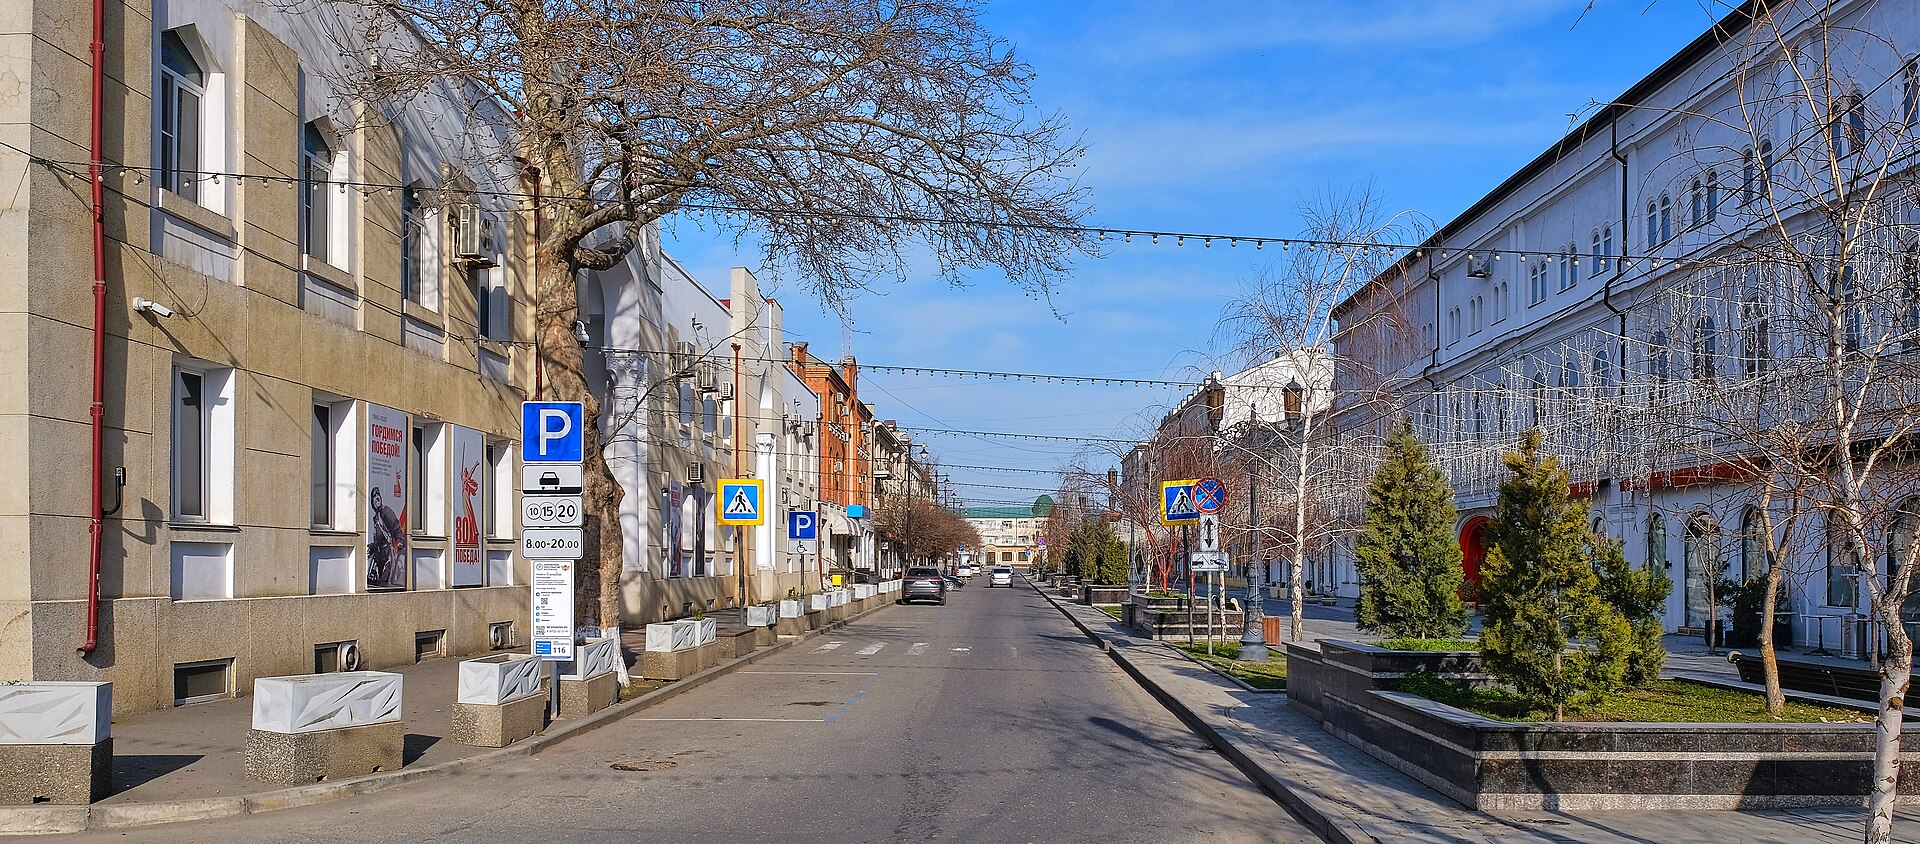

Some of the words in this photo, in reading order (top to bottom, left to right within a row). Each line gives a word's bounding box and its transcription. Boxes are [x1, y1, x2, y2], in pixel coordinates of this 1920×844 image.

[371, 423, 403, 442] ГОРДИМСЯ
[540, 409, 572, 456] P
[529, 507, 539, 516] 10
[542, 506, 554, 517] 15
[558, 504, 576, 518] 20
[456, 516, 469, 543] 80
[796, 514, 812, 537] P
[525, 538, 579, 549] 8.00-20.00
[455, 548, 480, 565] ПОБЕДА!
[553, 646, 566, 654] 116
